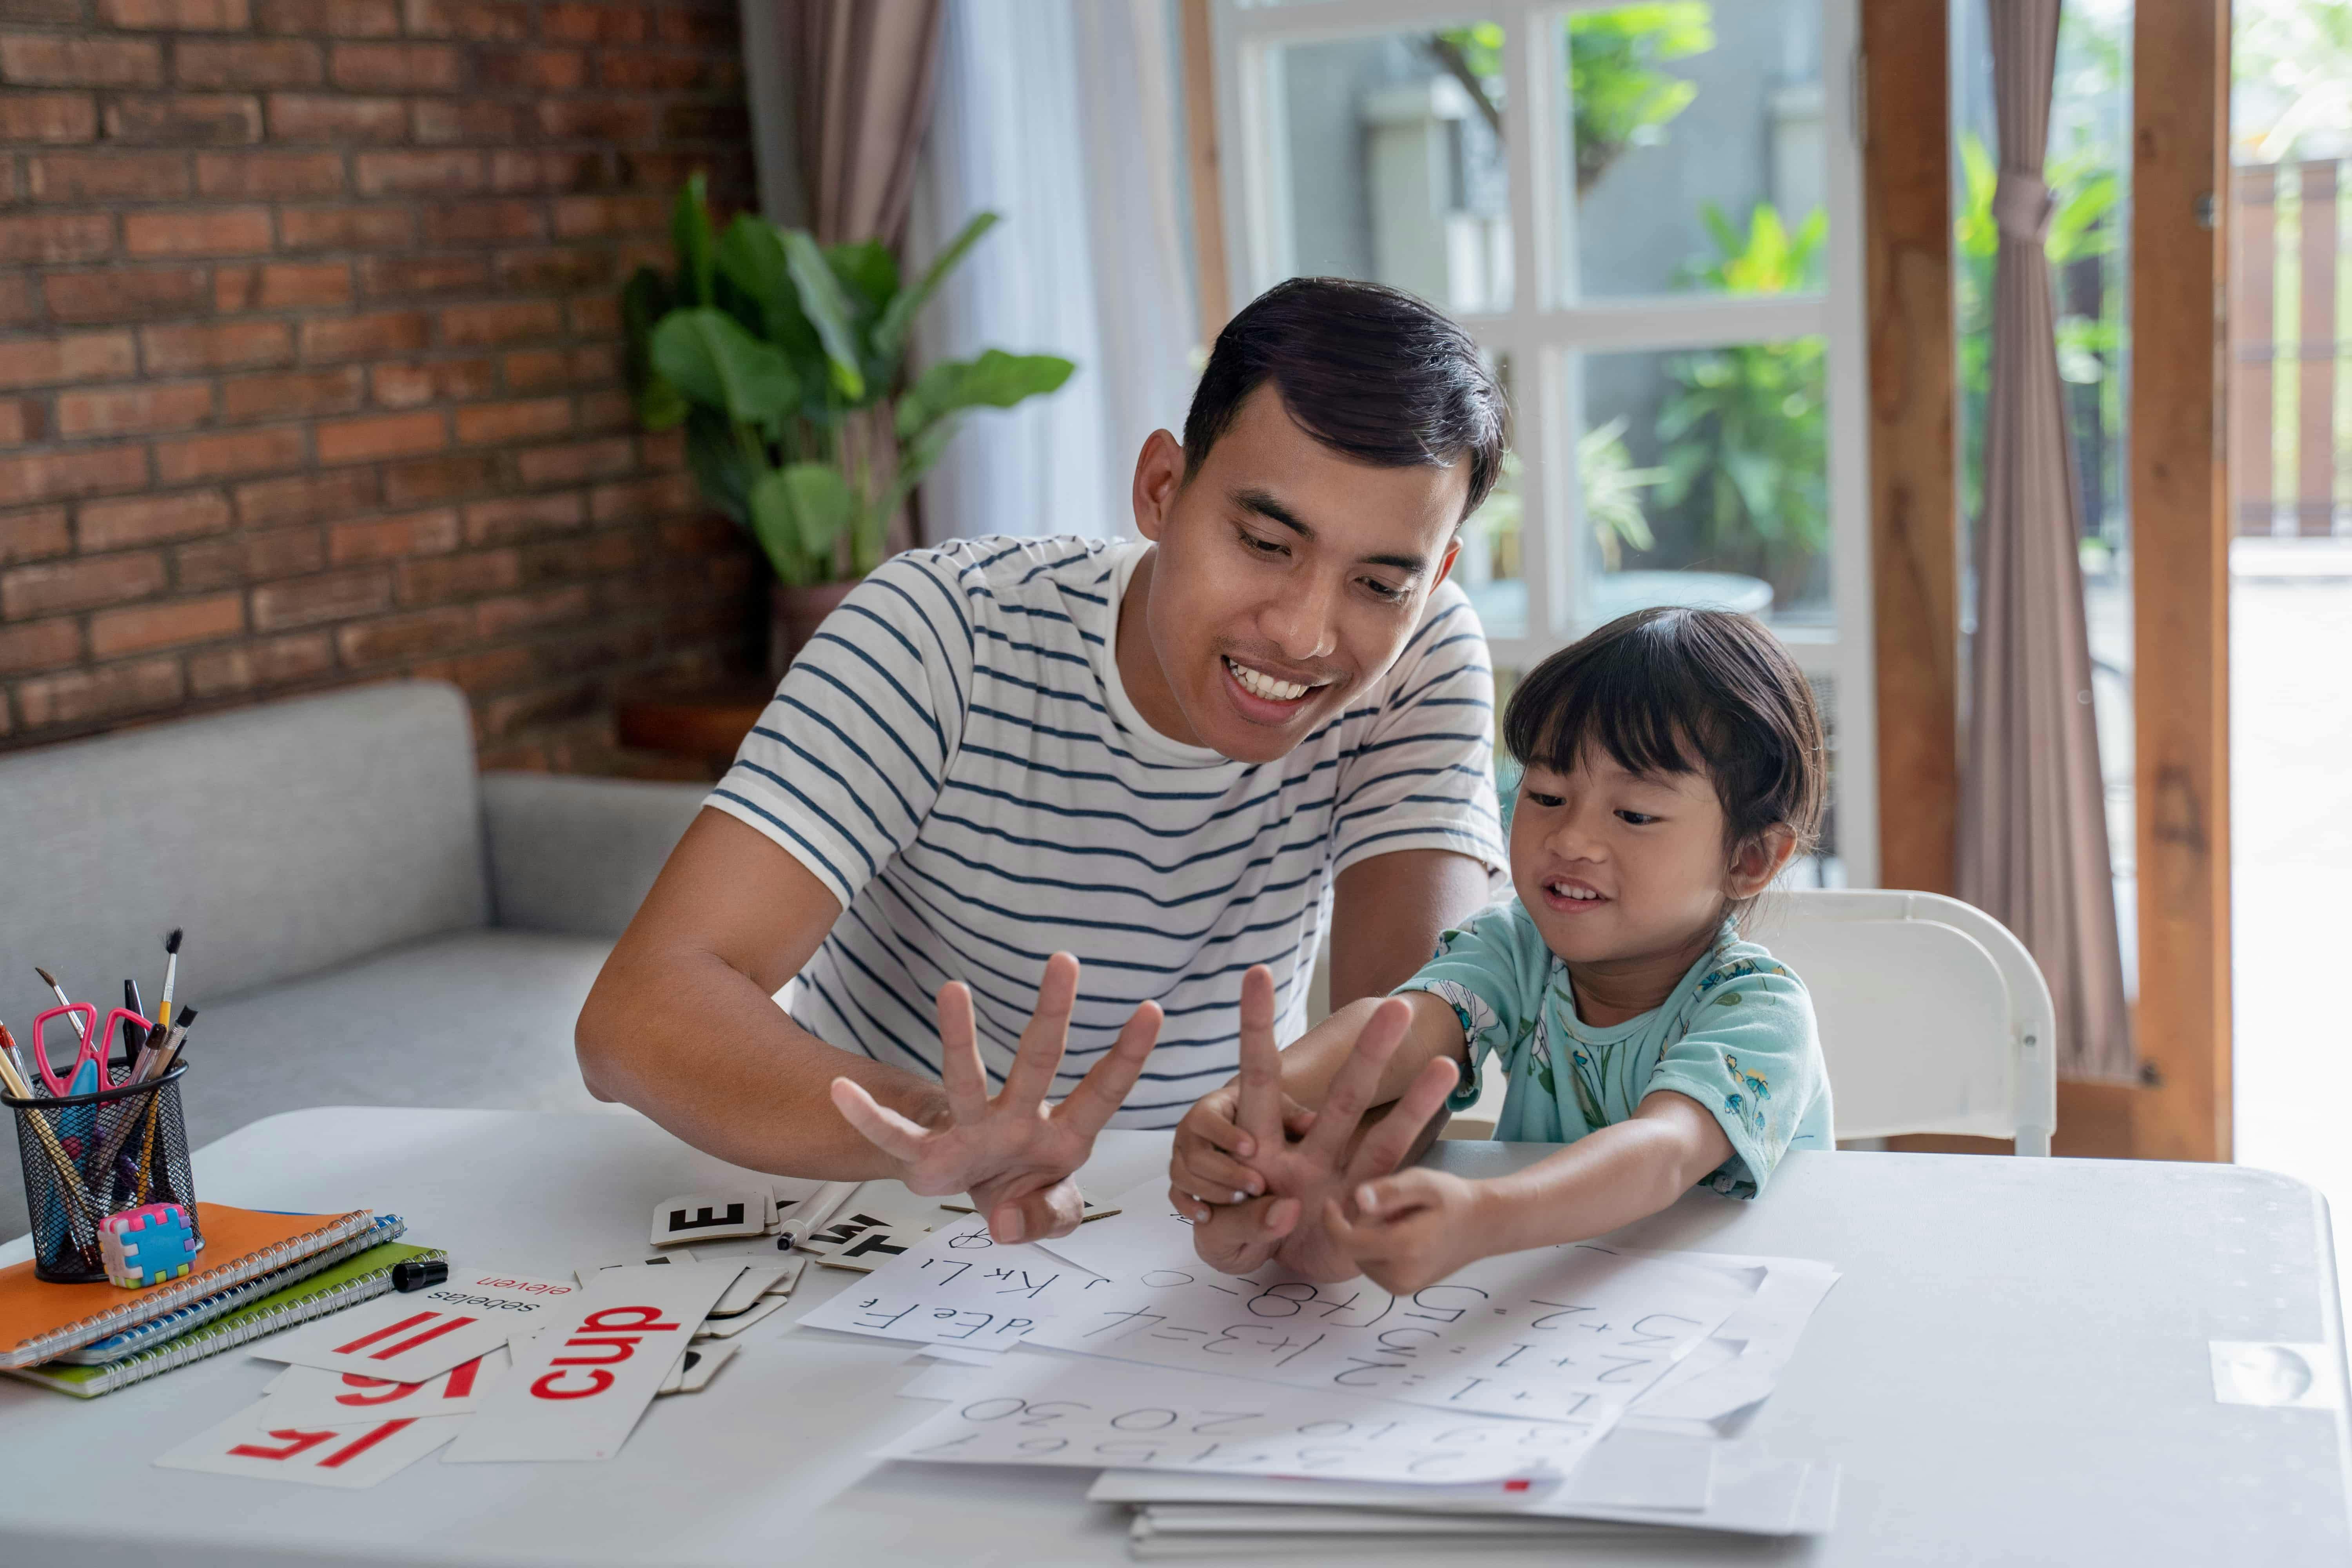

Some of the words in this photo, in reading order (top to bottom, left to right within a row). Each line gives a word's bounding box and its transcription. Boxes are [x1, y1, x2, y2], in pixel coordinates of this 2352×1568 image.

[669, 1203, 744, 1232] E
[842, 1234, 909, 1257] T
[476, 1277, 572, 1295] eleven
[427, 1291, 540, 1312] sebelas
[1403, 1285, 1489, 1322] 5
[1530, 1300, 1597, 1329] 2
[1376, 1327, 1440, 1357] 3
[1618, 1314, 1703, 1349] 3
[530, 1306, 681, 1400] cup
[1496, 1342, 1536, 1367] 1
[1334, 1357, 1407, 1386] 2
[1597, 1354, 1652, 1383] 2
[1450, 1376, 1492, 1401] 1
[961, 1398, 1093, 1427] 30
[1111, 1408, 1265, 1435] 20
[1013, 1437, 1069, 1457] 6
